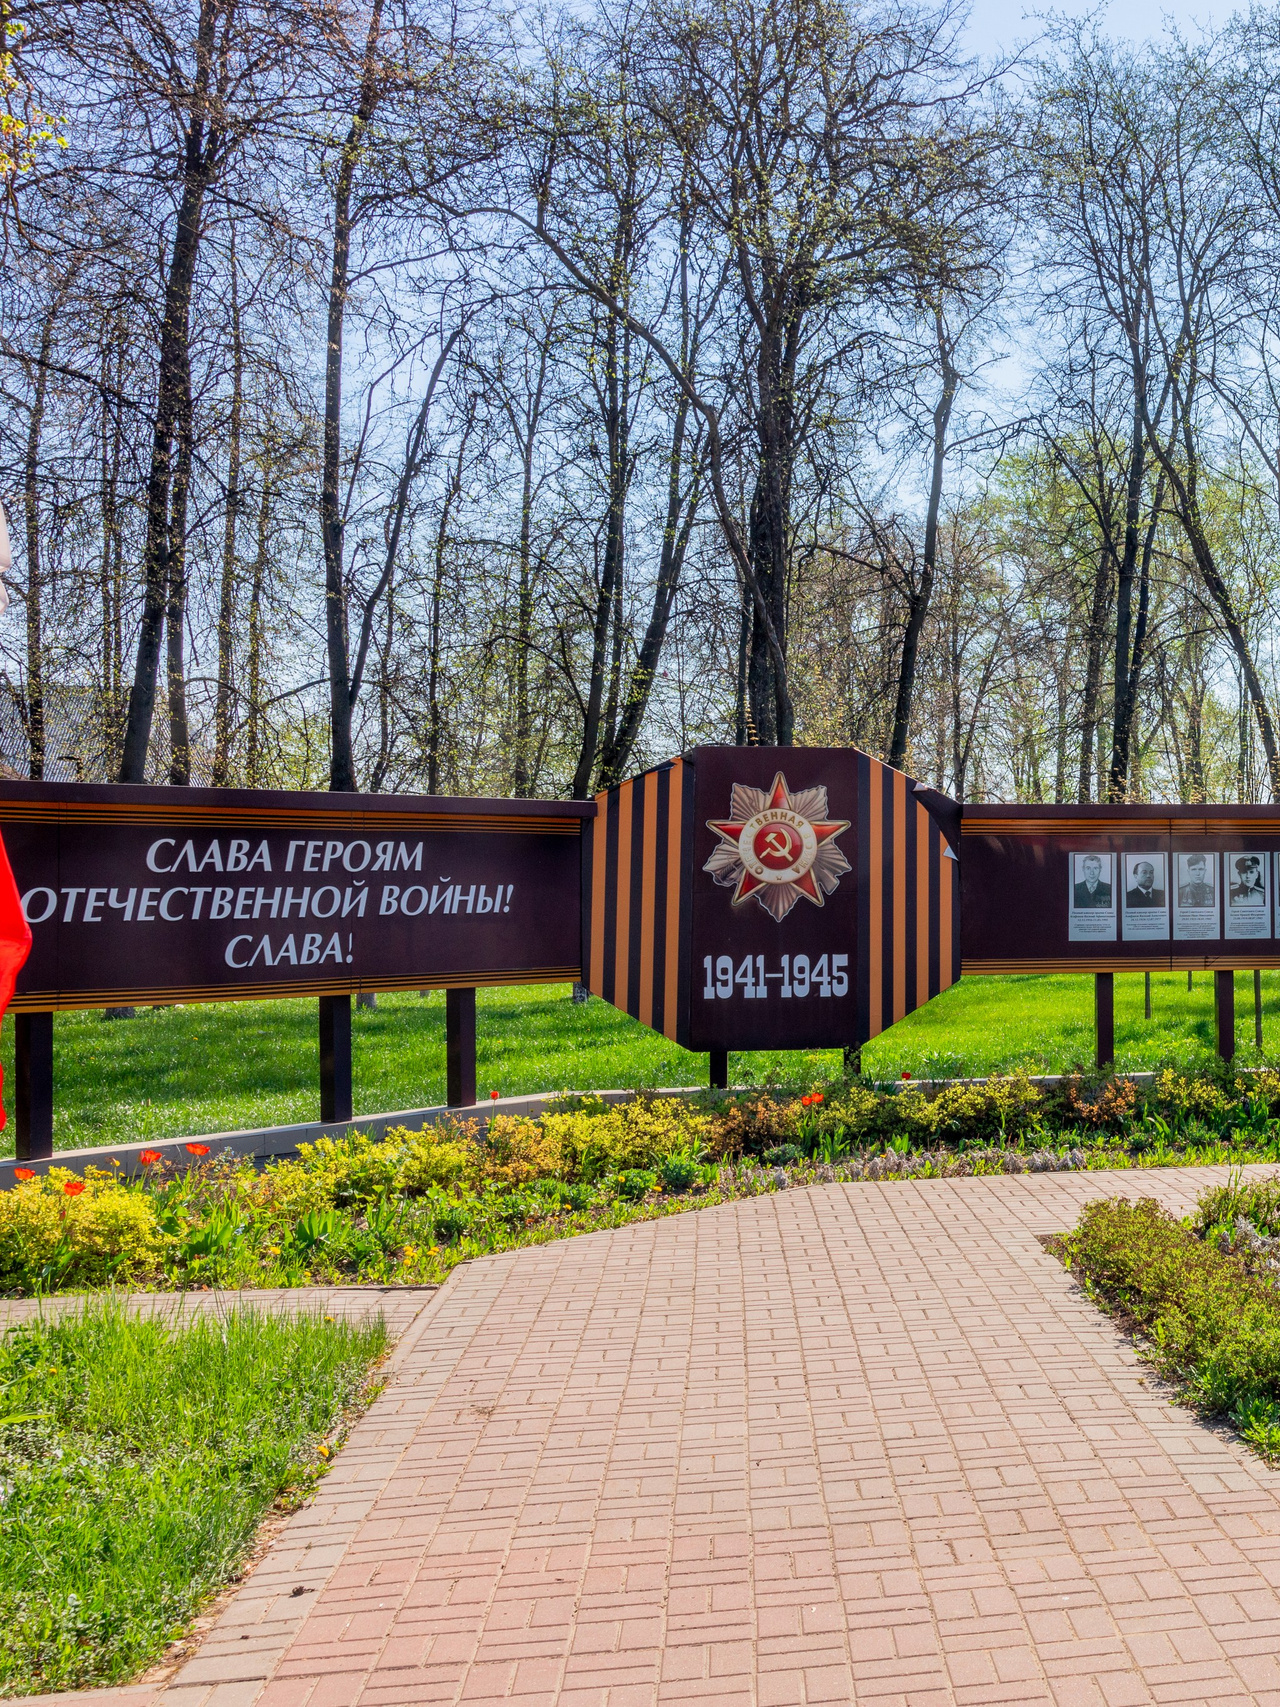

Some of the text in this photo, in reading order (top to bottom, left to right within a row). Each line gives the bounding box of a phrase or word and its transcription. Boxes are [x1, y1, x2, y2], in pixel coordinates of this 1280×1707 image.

[146, 838, 423, 873] СЛАВА ГЕРОЯМ
[20, 876, 514, 923] ОТЕЧЕСТВЕННОЙ ВОЙНЫ!
[224, 932, 353, 969] СЛАВА!
